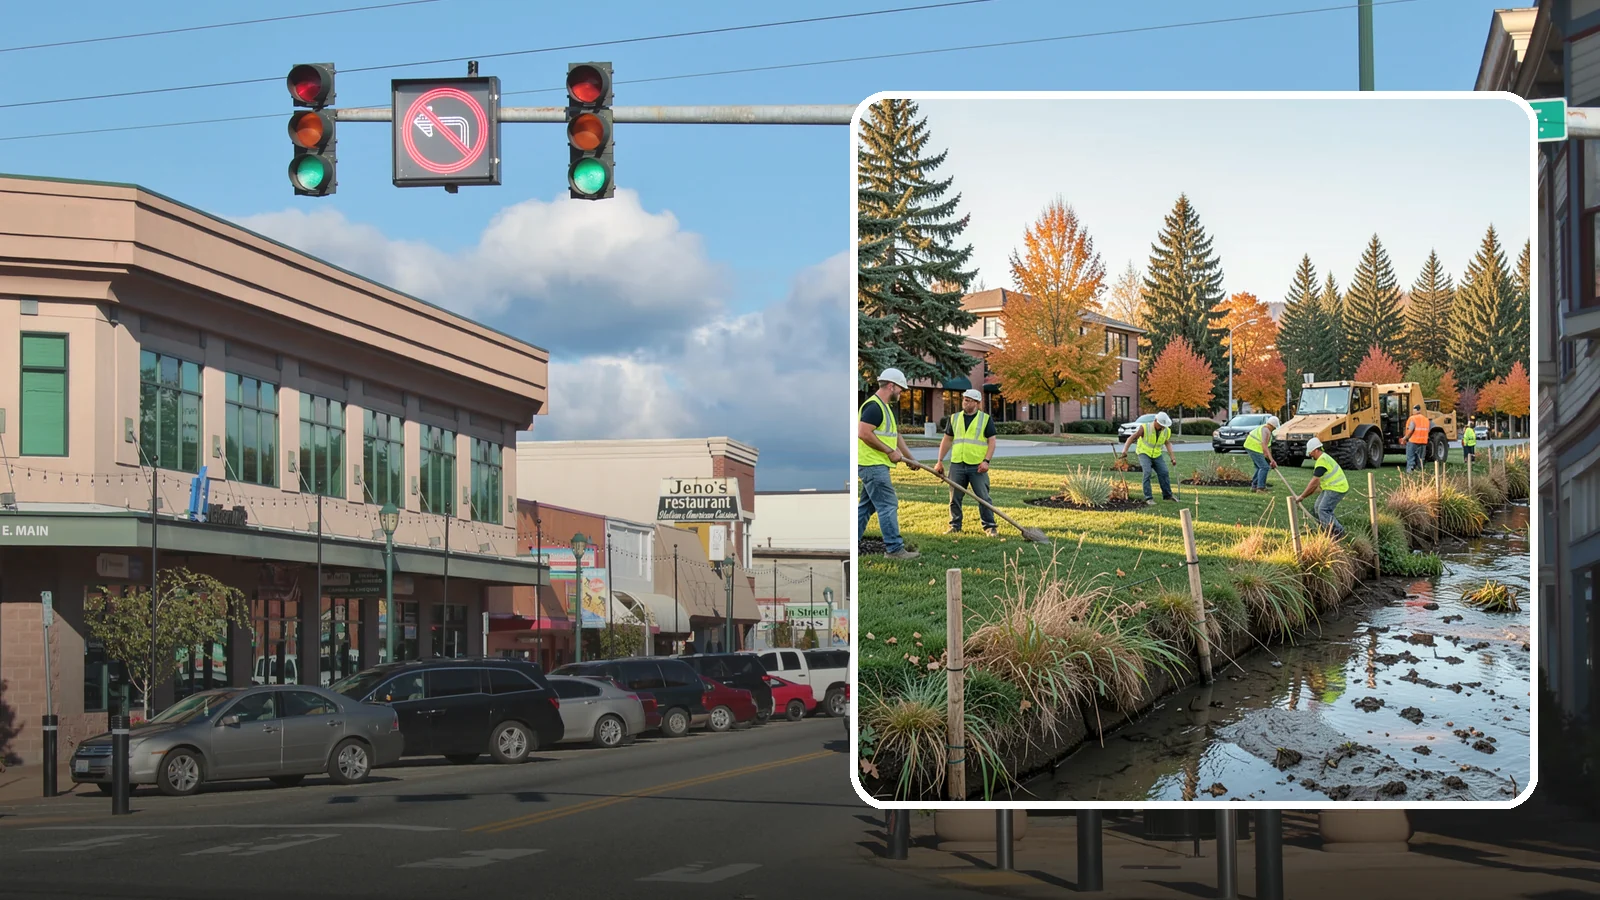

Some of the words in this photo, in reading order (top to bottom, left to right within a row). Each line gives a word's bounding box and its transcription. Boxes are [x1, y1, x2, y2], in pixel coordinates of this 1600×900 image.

[669, 480, 728, 495] Jeno's
[664, 496, 732, 509] restaurant
[658, 510, 681, 520] Italian
[686, 510, 714, 520] American
[714, 509, 738, 519] Cuisine
[2, 525, 13, 536] E.
[15, 525, 49, 536] MAIN
[785, 608, 795, 616] in
[797, 608, 828, 616] Street
